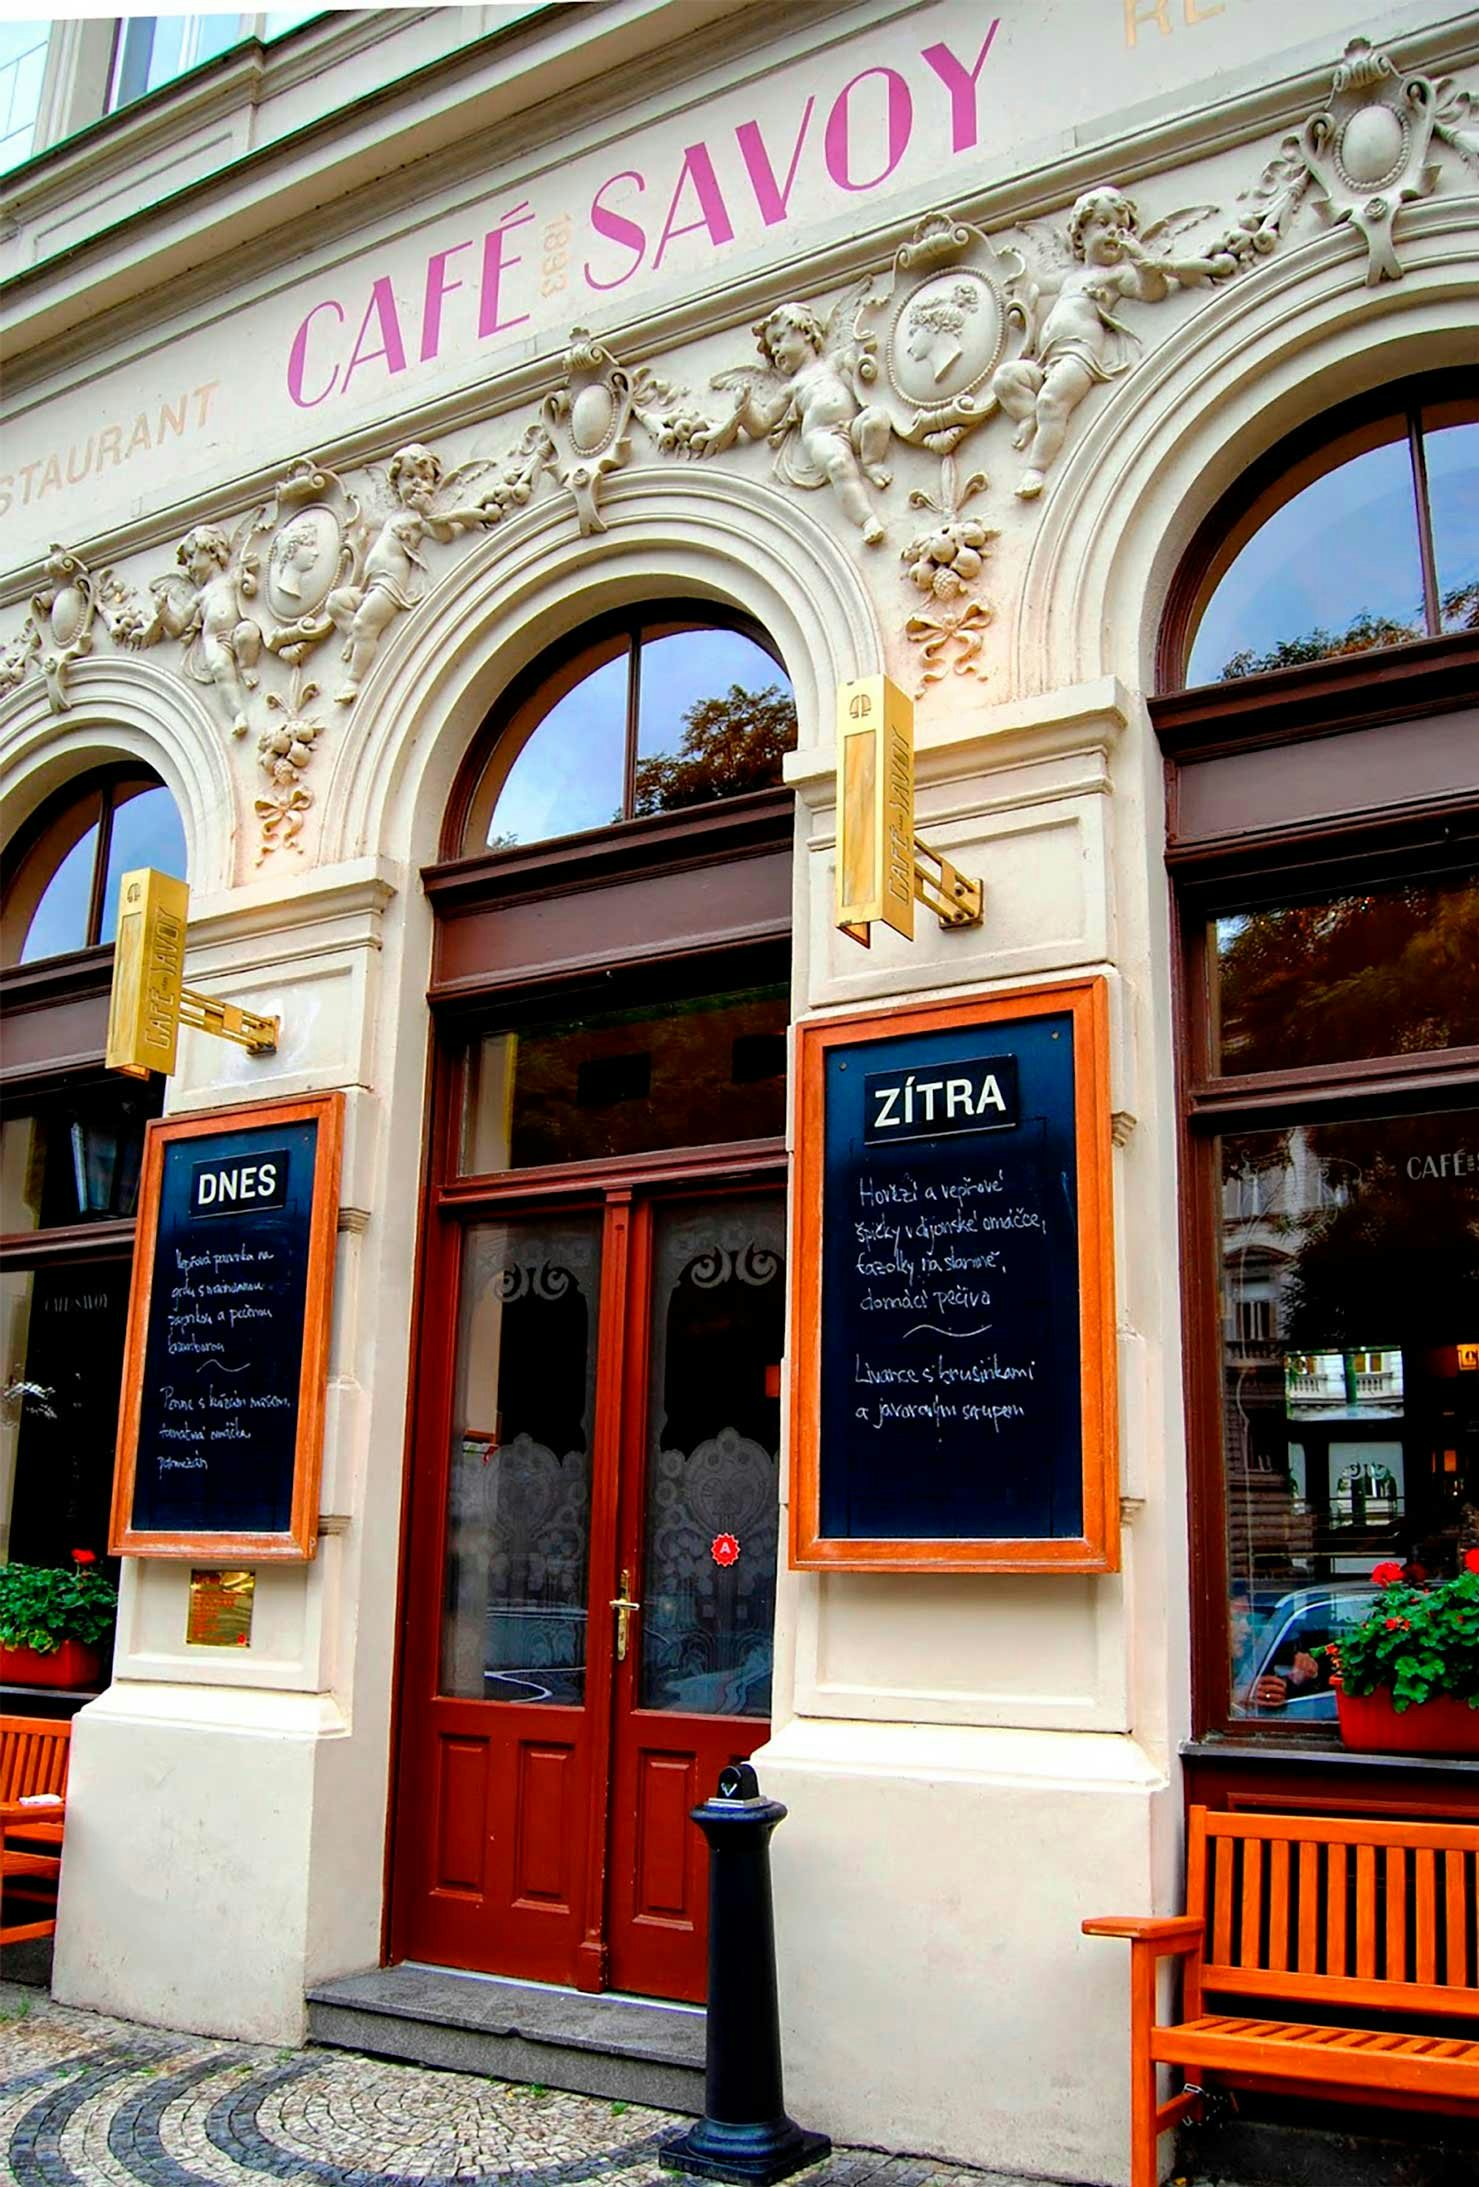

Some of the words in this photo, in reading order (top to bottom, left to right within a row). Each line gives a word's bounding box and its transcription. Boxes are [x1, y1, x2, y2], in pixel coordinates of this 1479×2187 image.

[287, 200, 537, 408] CAFÉ
[583, 18, 1001, 291] SAVOY
[541, 212, 571, 298] 1893
[888, 723, 910, 816] SAVOY
[888, 823, 910, 906] CAFÉ
[150, 905, 184, 977] SAVOY
[144, 985, 174, 1050] CAFÉ
[873, 1075, 1007, 1128] ZÍTRA
[197, 1163, 277, 1205] DNES
[924, 1184, 938, 1201] a
[1406, 1148, 1468, 1181] CAFÉ
[932, 1284, 992, 1315] pečivo
[854, 1407, 869, 1420] a
